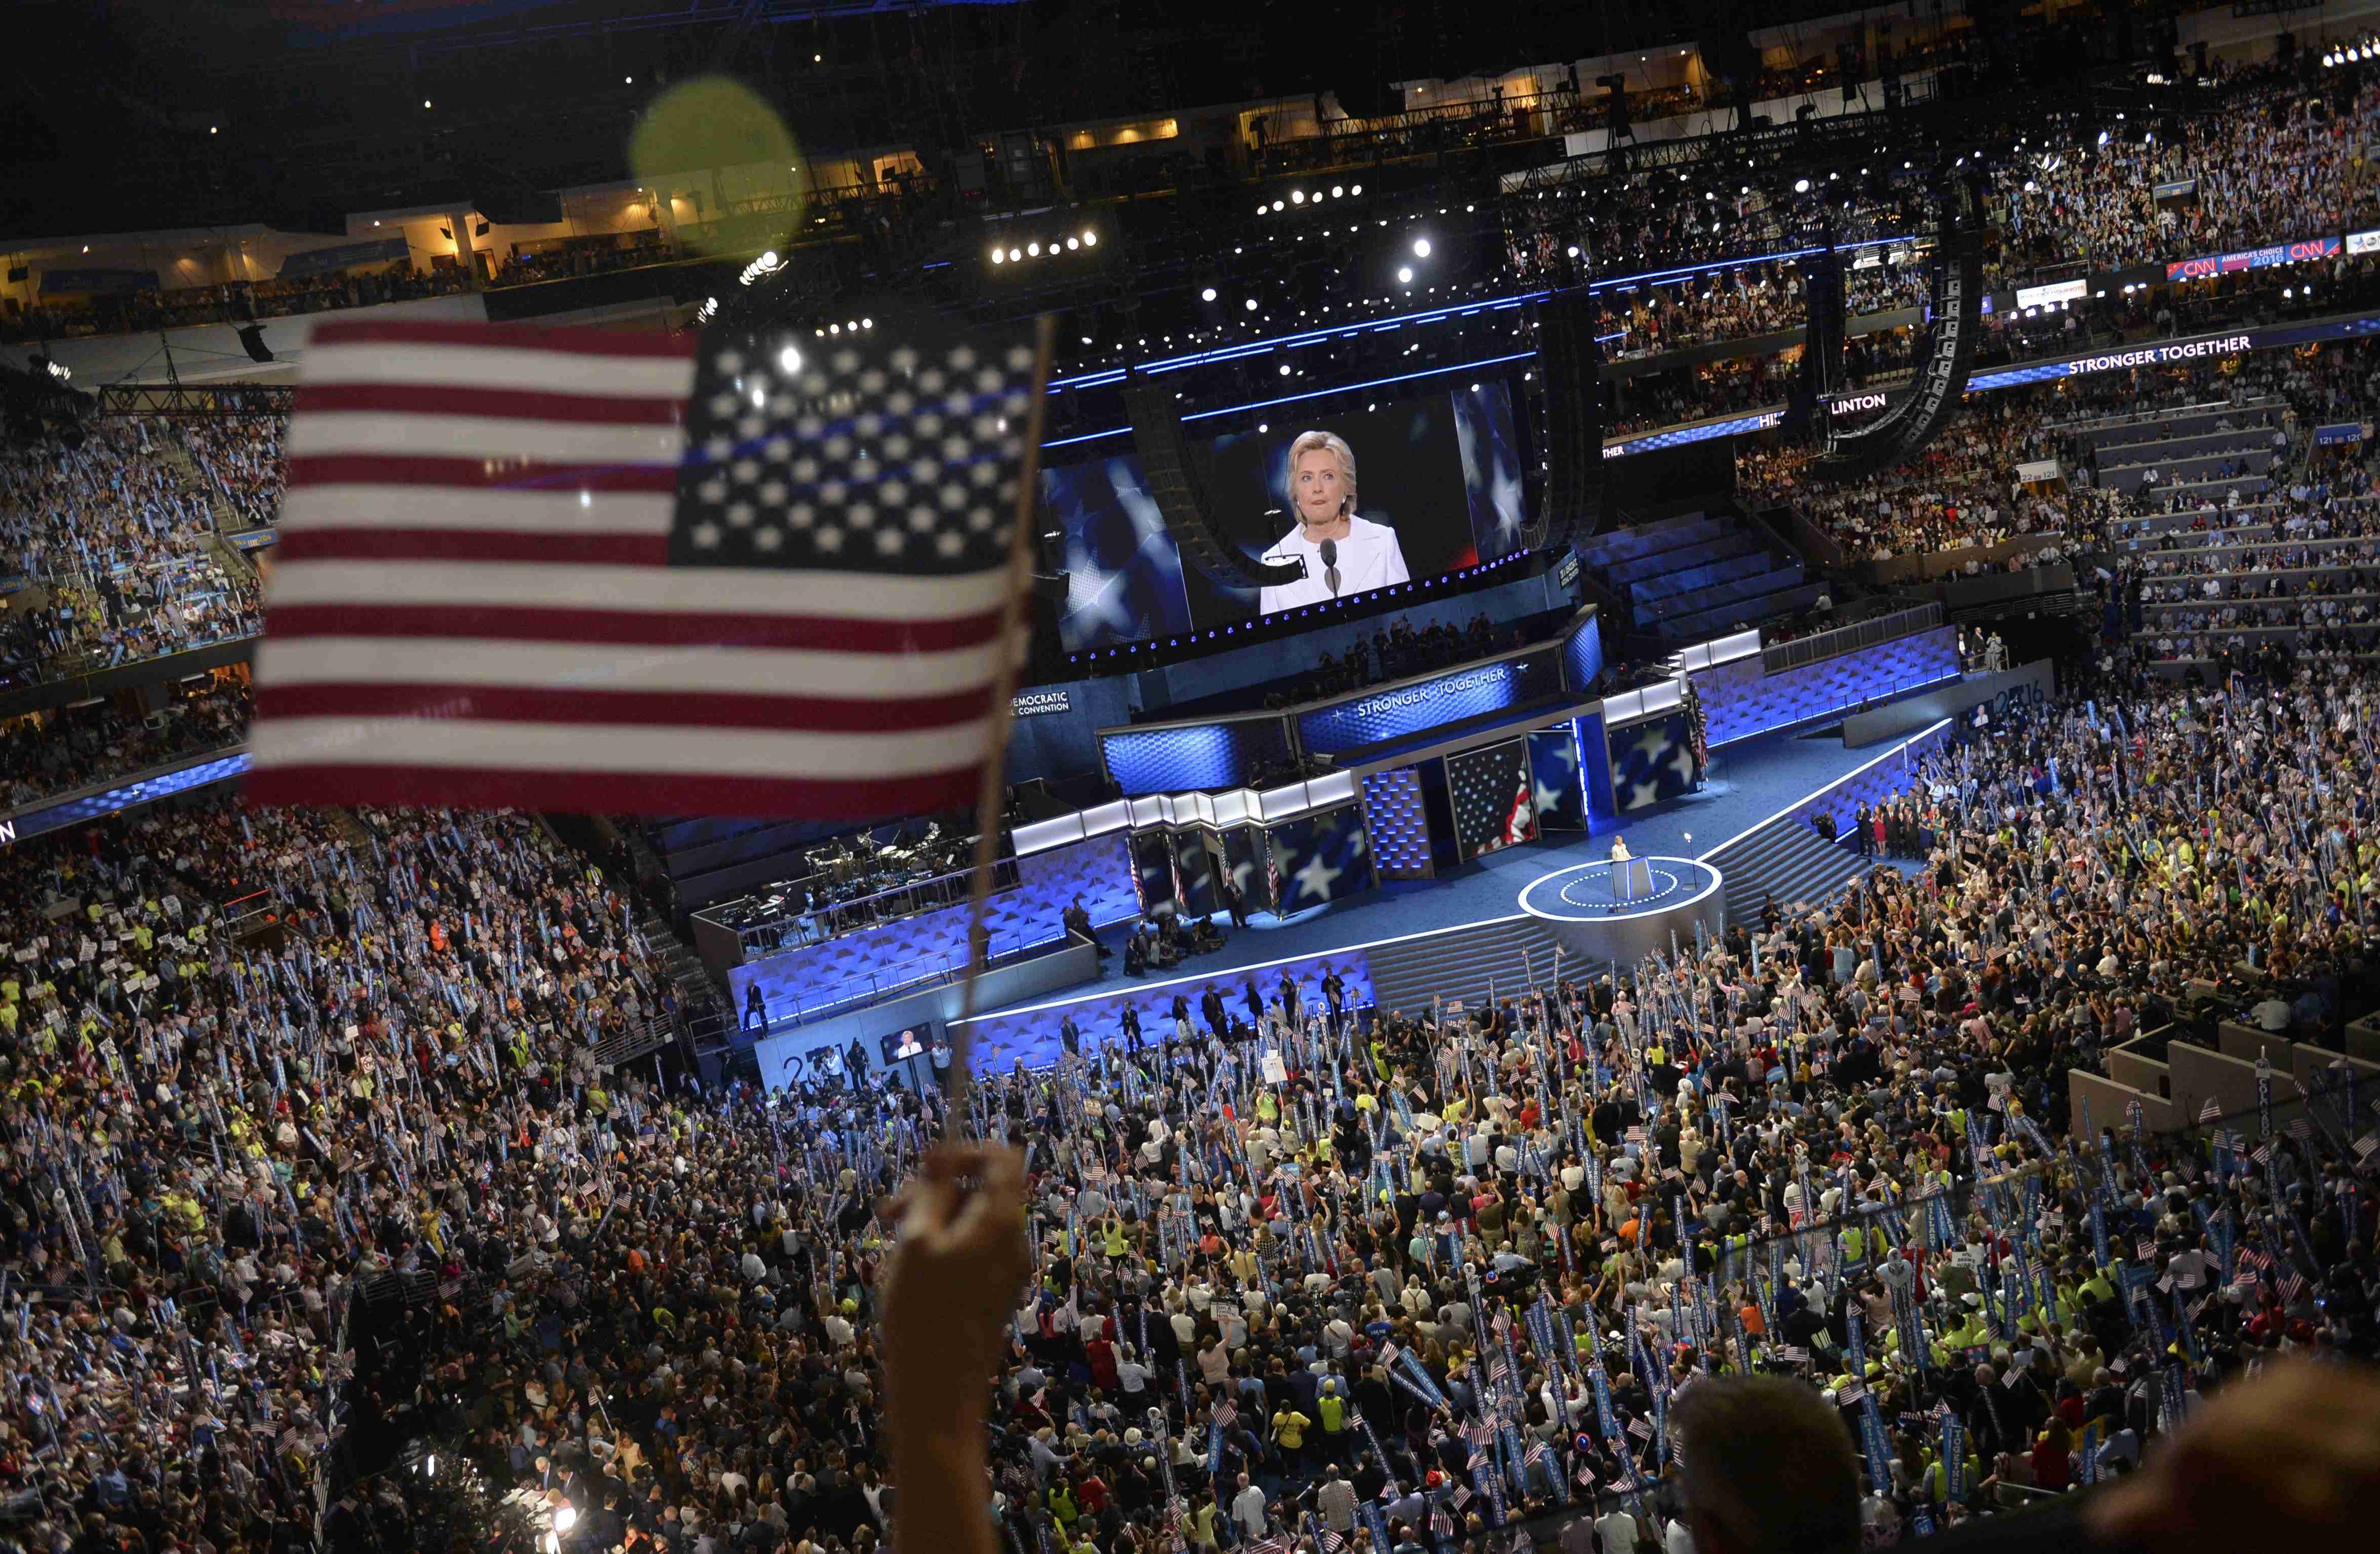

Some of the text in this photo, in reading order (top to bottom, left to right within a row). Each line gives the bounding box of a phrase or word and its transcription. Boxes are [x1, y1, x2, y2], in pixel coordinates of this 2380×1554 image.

[2185, 258, 2215, 275] CNN
[2222, 247, 2284, 262] AMERICA'S CHOICE
[2253, 255, 2284, 266] 2016
[2291, 239, 2324, 258] CNN
[2069, 336, 2251, 375] STRONGER TOGETHER
[1831, 393, 1886, 415] LINTON
[2319, 436, 2332, 445] 121
[1019, 703, 1069, 715] CONVENTION
[1357, 668, 1507, 717] STRONGER TOGETHER
[1487, 1058, 1496, 1094] HILLARY
[1393, 1143, 1410, 1153] USA
[1518, 1135, 1526, 1172] HILLARY
[1576, 1115, 1584, 1155] HILLARY
[2021, 1116, 2054, 1158] STRONGER
[2102, 1157, 2121, 1206] STRONGER
[1639, 1203, 1648, 1247] HILLARY
[1881, 1214, 1899, 1247] OGETHER
[1927, 1200, 1937, 1246] HILLARY
[1943, 1198, 1955, 1237] ILLARY
[1304, 1228, 1315, 1265] HILLARY
[1257, 1255, 1271, 1301] HILLARY
[1754, 1275, 1771, 1323] TOGETHER
[2041, 1269, 2056, 1322] HILLARY
[1542, 1297, 1554, 1344] STRONGER
[1585, 1302, 1601, 1354] TOGETHER
[1672, 1285, 1682, 1334] TOGETHER
[2006, 1275, 2015, 1335] HILLARY
[1661, 1348, 1670, 1386] OGETHE
[1734, 1319, 1751, 1376] STRONGER
[1848, 1319, 1864, 1376] HILLARY
[1403, 1352, 1438, 1398] HILLARY
[1552, 1363, 1565, 1416] STRONGER
[1595, 1373, 1610, 1428] HILLARY
[1506, 1426, 1524, 1482] HILLARY
[1863, 1418, 1883, 1482] HILLARY
[1952, 1429, 1960, 1493] TOGETHER
[1487, 1464, 1505, 1525] TOGETHER
